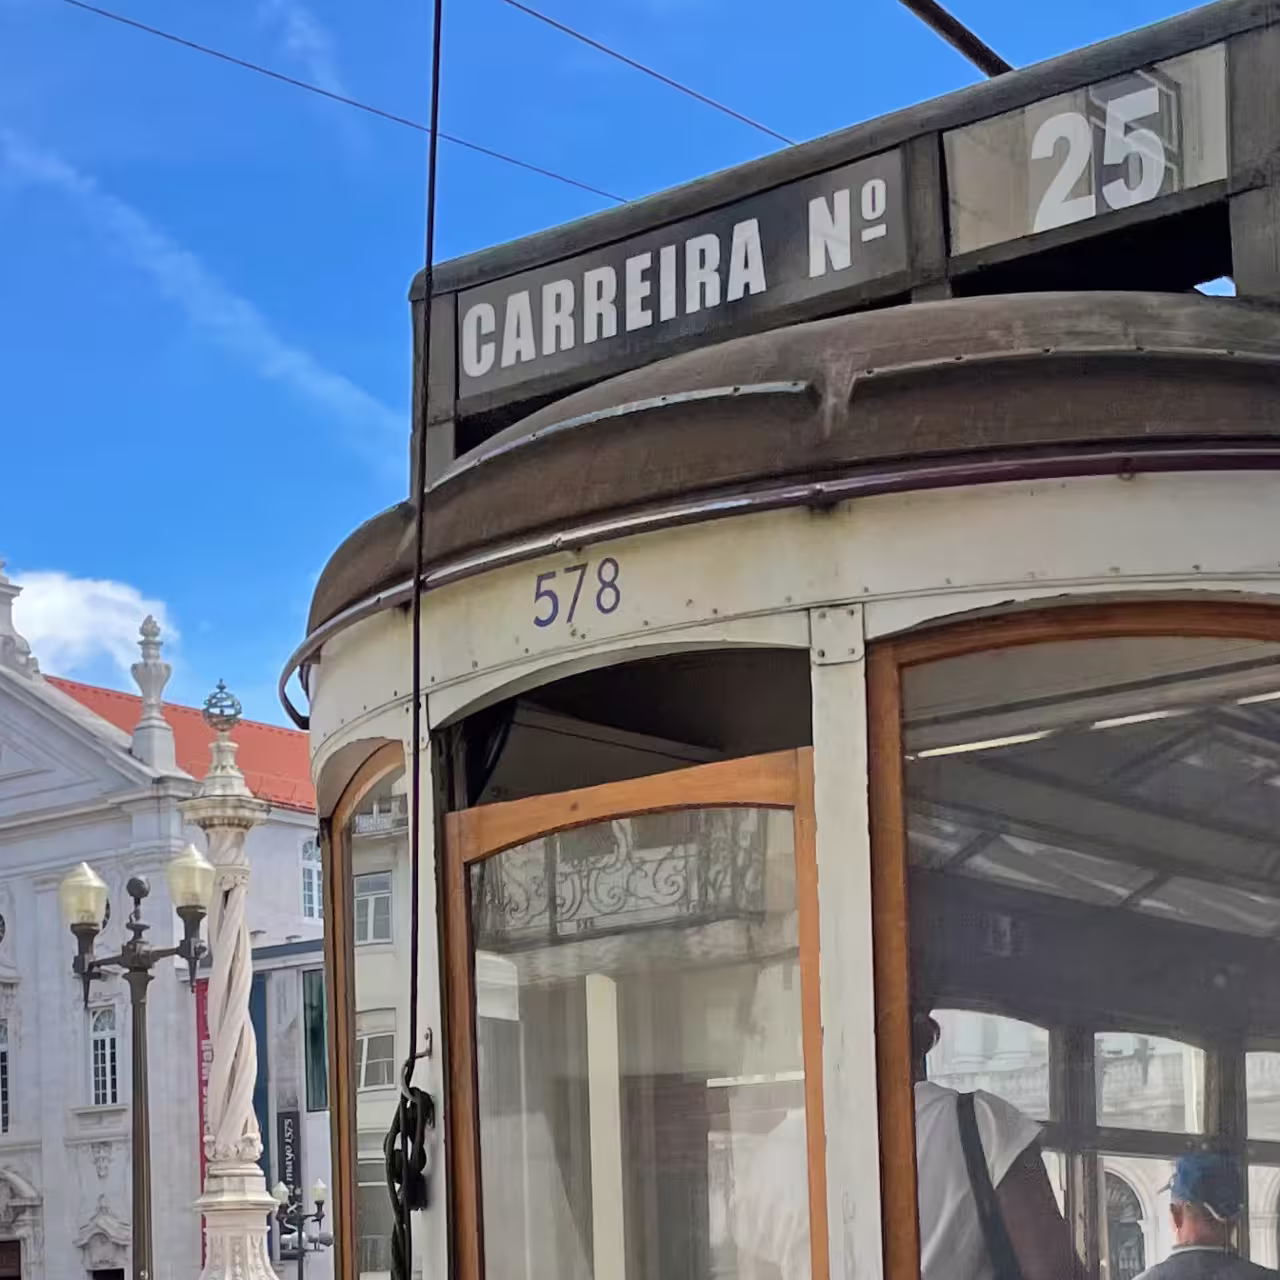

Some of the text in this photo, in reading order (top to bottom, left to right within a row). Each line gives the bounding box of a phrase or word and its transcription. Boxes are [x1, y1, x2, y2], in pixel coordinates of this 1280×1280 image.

[461, 86, 1166, 378] CARREIRA Nº 25
[533, 556, 621, 628] 578
